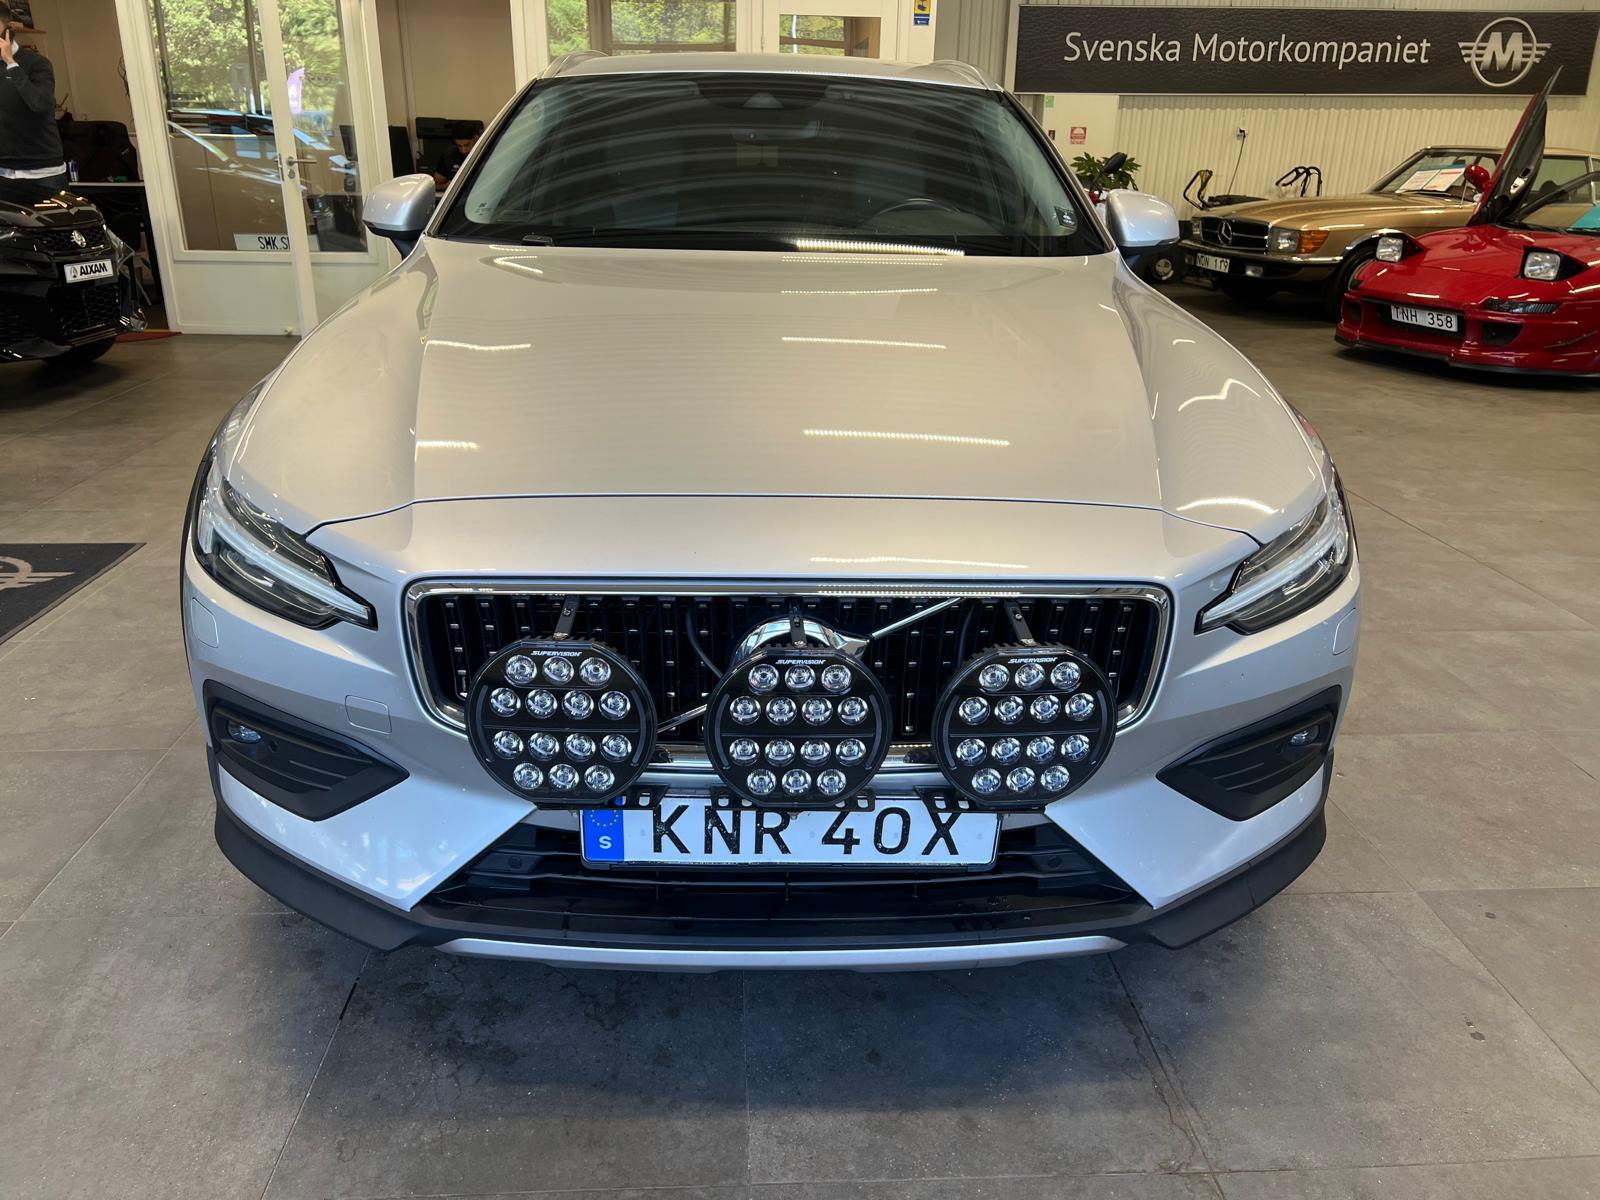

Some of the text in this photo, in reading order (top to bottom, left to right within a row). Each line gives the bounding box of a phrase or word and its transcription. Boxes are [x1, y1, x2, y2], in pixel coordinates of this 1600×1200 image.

[1063, 32, 1431, 69] Svenska Motorkompaniet
[80, 262, 108, 276] AIXAM
[1393, 304, 1453, 329] TNH 358
[1008, 656, 1059, 664] SUPERVISION
[653, 805, 960, 855] KNR 40X
[599, 836, 612, 849] S
